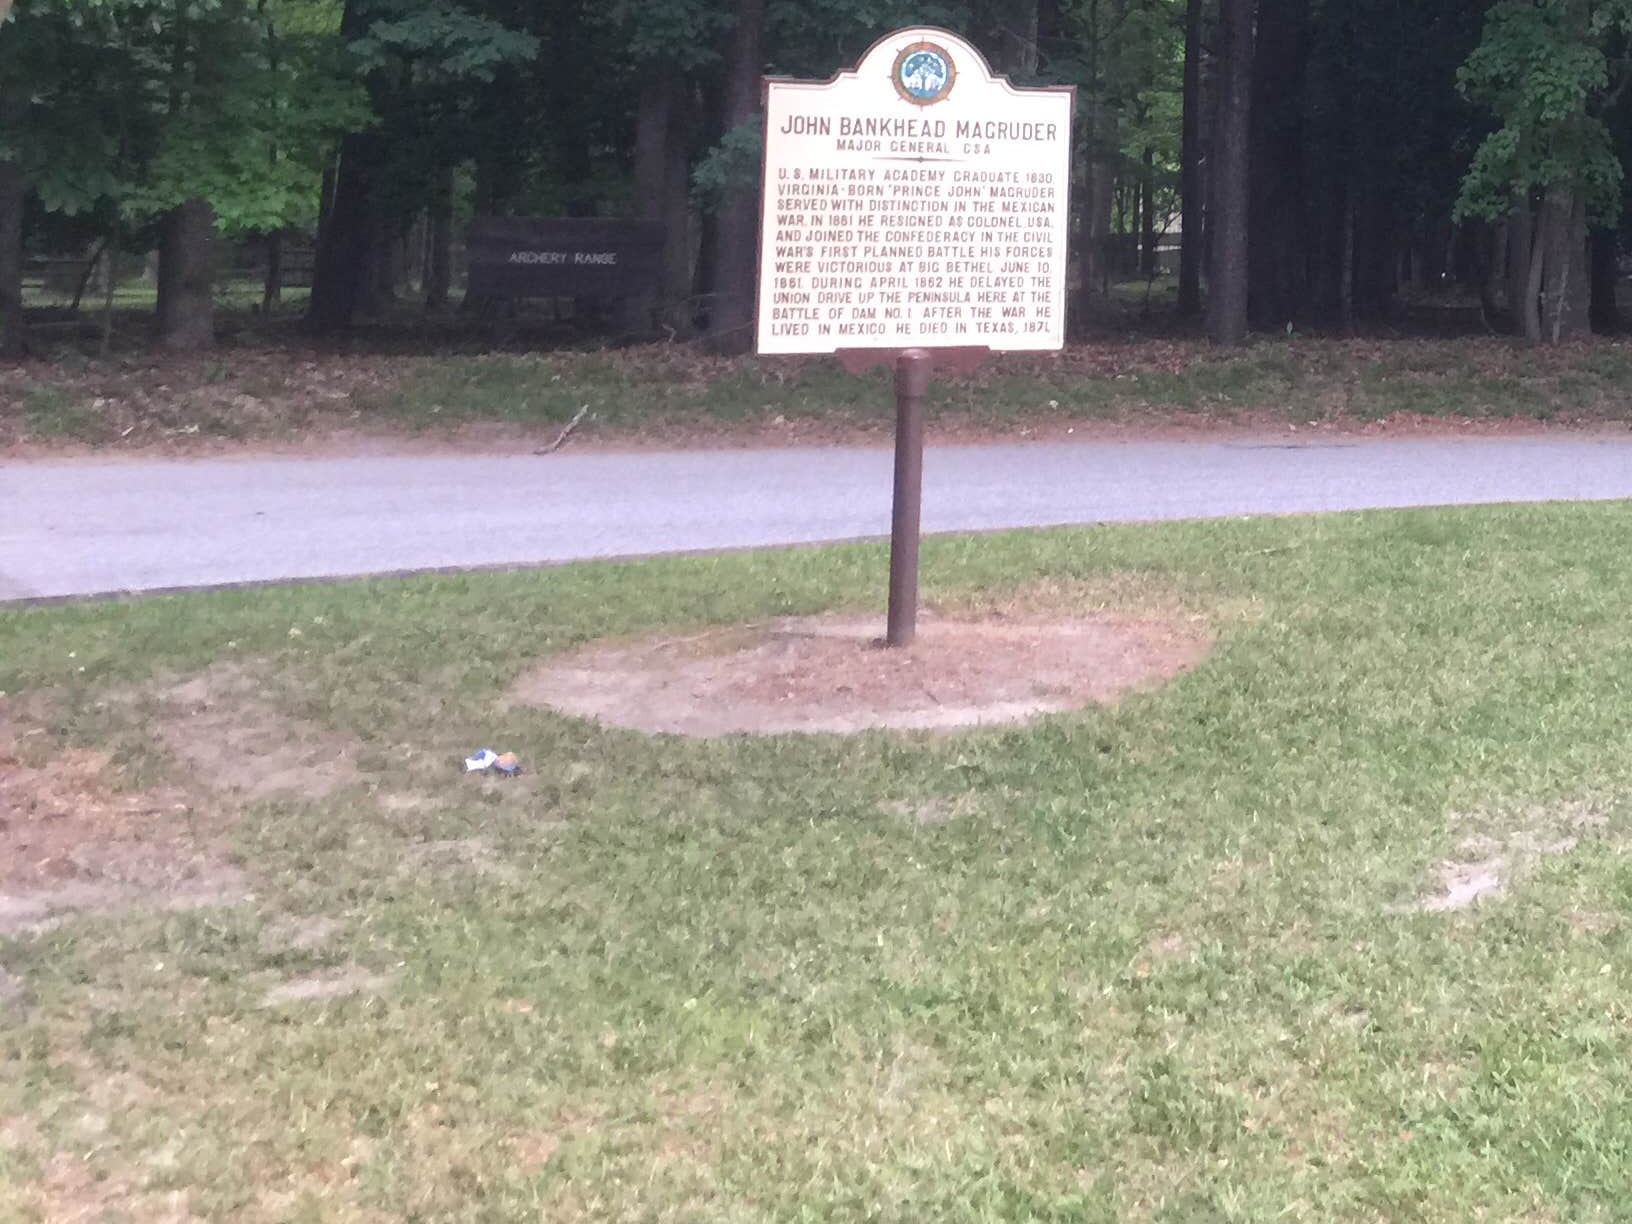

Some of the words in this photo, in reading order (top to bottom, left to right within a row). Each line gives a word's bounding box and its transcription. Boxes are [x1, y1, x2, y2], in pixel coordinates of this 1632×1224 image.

[780, 115, 831, 135] JOHN
[840, 117, 946, 138] BANKHEAD
[956, 120, 1057, 141] MAGRUDER
[836, 139, 881, 151] MAJOR
[809, 168, 875, 180] MILITARY
[883, 169, 945, 182] ACADEMY
[954, 170, 1019, 183] GRADUATE
[990, 186, 1055, 198] MAGRUDER
[777, 198, 828, 211] SERVED
[831, 199, 863, 211] WITH
[869, 199, 948, 211] DISTINCTION
[954, 201, 966, 212] IN
[973, 201, 995, 212] THE
[1002, 201, 1055, 213] MEXICAN
[811, 214, 823, 226] IN
[829, 215, 853, 226] 1861
[858, 215, 874, 226] HE
[881, 215, 942, 227] RESIGNED
[948, 216, 963, 227] AS
[776, 230, 802, 242] AND
[805, 230, 854, 242] JOINED
[857, 230, 880, 242] THE
[885, 230, 975, 242] CONFEDERACY
[981, 231, 993, 242] IN
[997, 232, 1019, 243] THE
[1023, 232, 1053, 243] CIVIL
[508, 251, 567, 264] ARCHERY
[574, 252, 617, 264] RANGE
[776, 246, 814, 258] WAR'S
[820, 246, 858, 258] FIRST
[864, 246, 923, 258] PLANNED
[928, 246, 975, 258] BATTLE
[980, 247, 1001, 258] HIS
[1006, 247, 1053, 258] FORCES
[775, 261, 811, 273] WERE
[817, 261, 892, 273] VICTORIOUS
[899, 261, 914, 273] AT
[918, 261, 940, 273] BIG
[946, 261, 993, 273] BETHEL
[1001, 262, 1030, 273] JUNE
[811, 277, 862, 289] DURING
[870, 277, 908, 289] APRIL
[915, 277, 943, 288] 1862
[949, 277, 964, 288] HE
[970, 276, 1024, 288] DELAYED
[1030, 276, 1052, 288] THE
[773, 292, 810, 304] UNION
[818, 292, 853, 304] DRIVE
[858, 292, 875, 303] UP
[879, 292, 902, 303] THE
[908, 291, 971, 303] PENINSULA
[977, 291, 1007, 303] HERE
[1012, 291, 1025, 303] AT
[1030, 291, 1051, 303] THE
[772, 307, 820, 320] BATTLE
[828, 307, 845, 319] OF
[852, 307, 876, 319] DAM
[923, 307, 962, 318] AFTER
[970, 307, 992, 318] THE
[1001, 307, 1026, 318] WAR
[1036, 307, 1051, 318] HE
[771, 323, 809, 336] LIVED
[818, 323, 831, 335] IN
[896, 323, 911, 335] HE
[919, 322, 948, 334] DIED
[955, 322, 967, 334] IN
